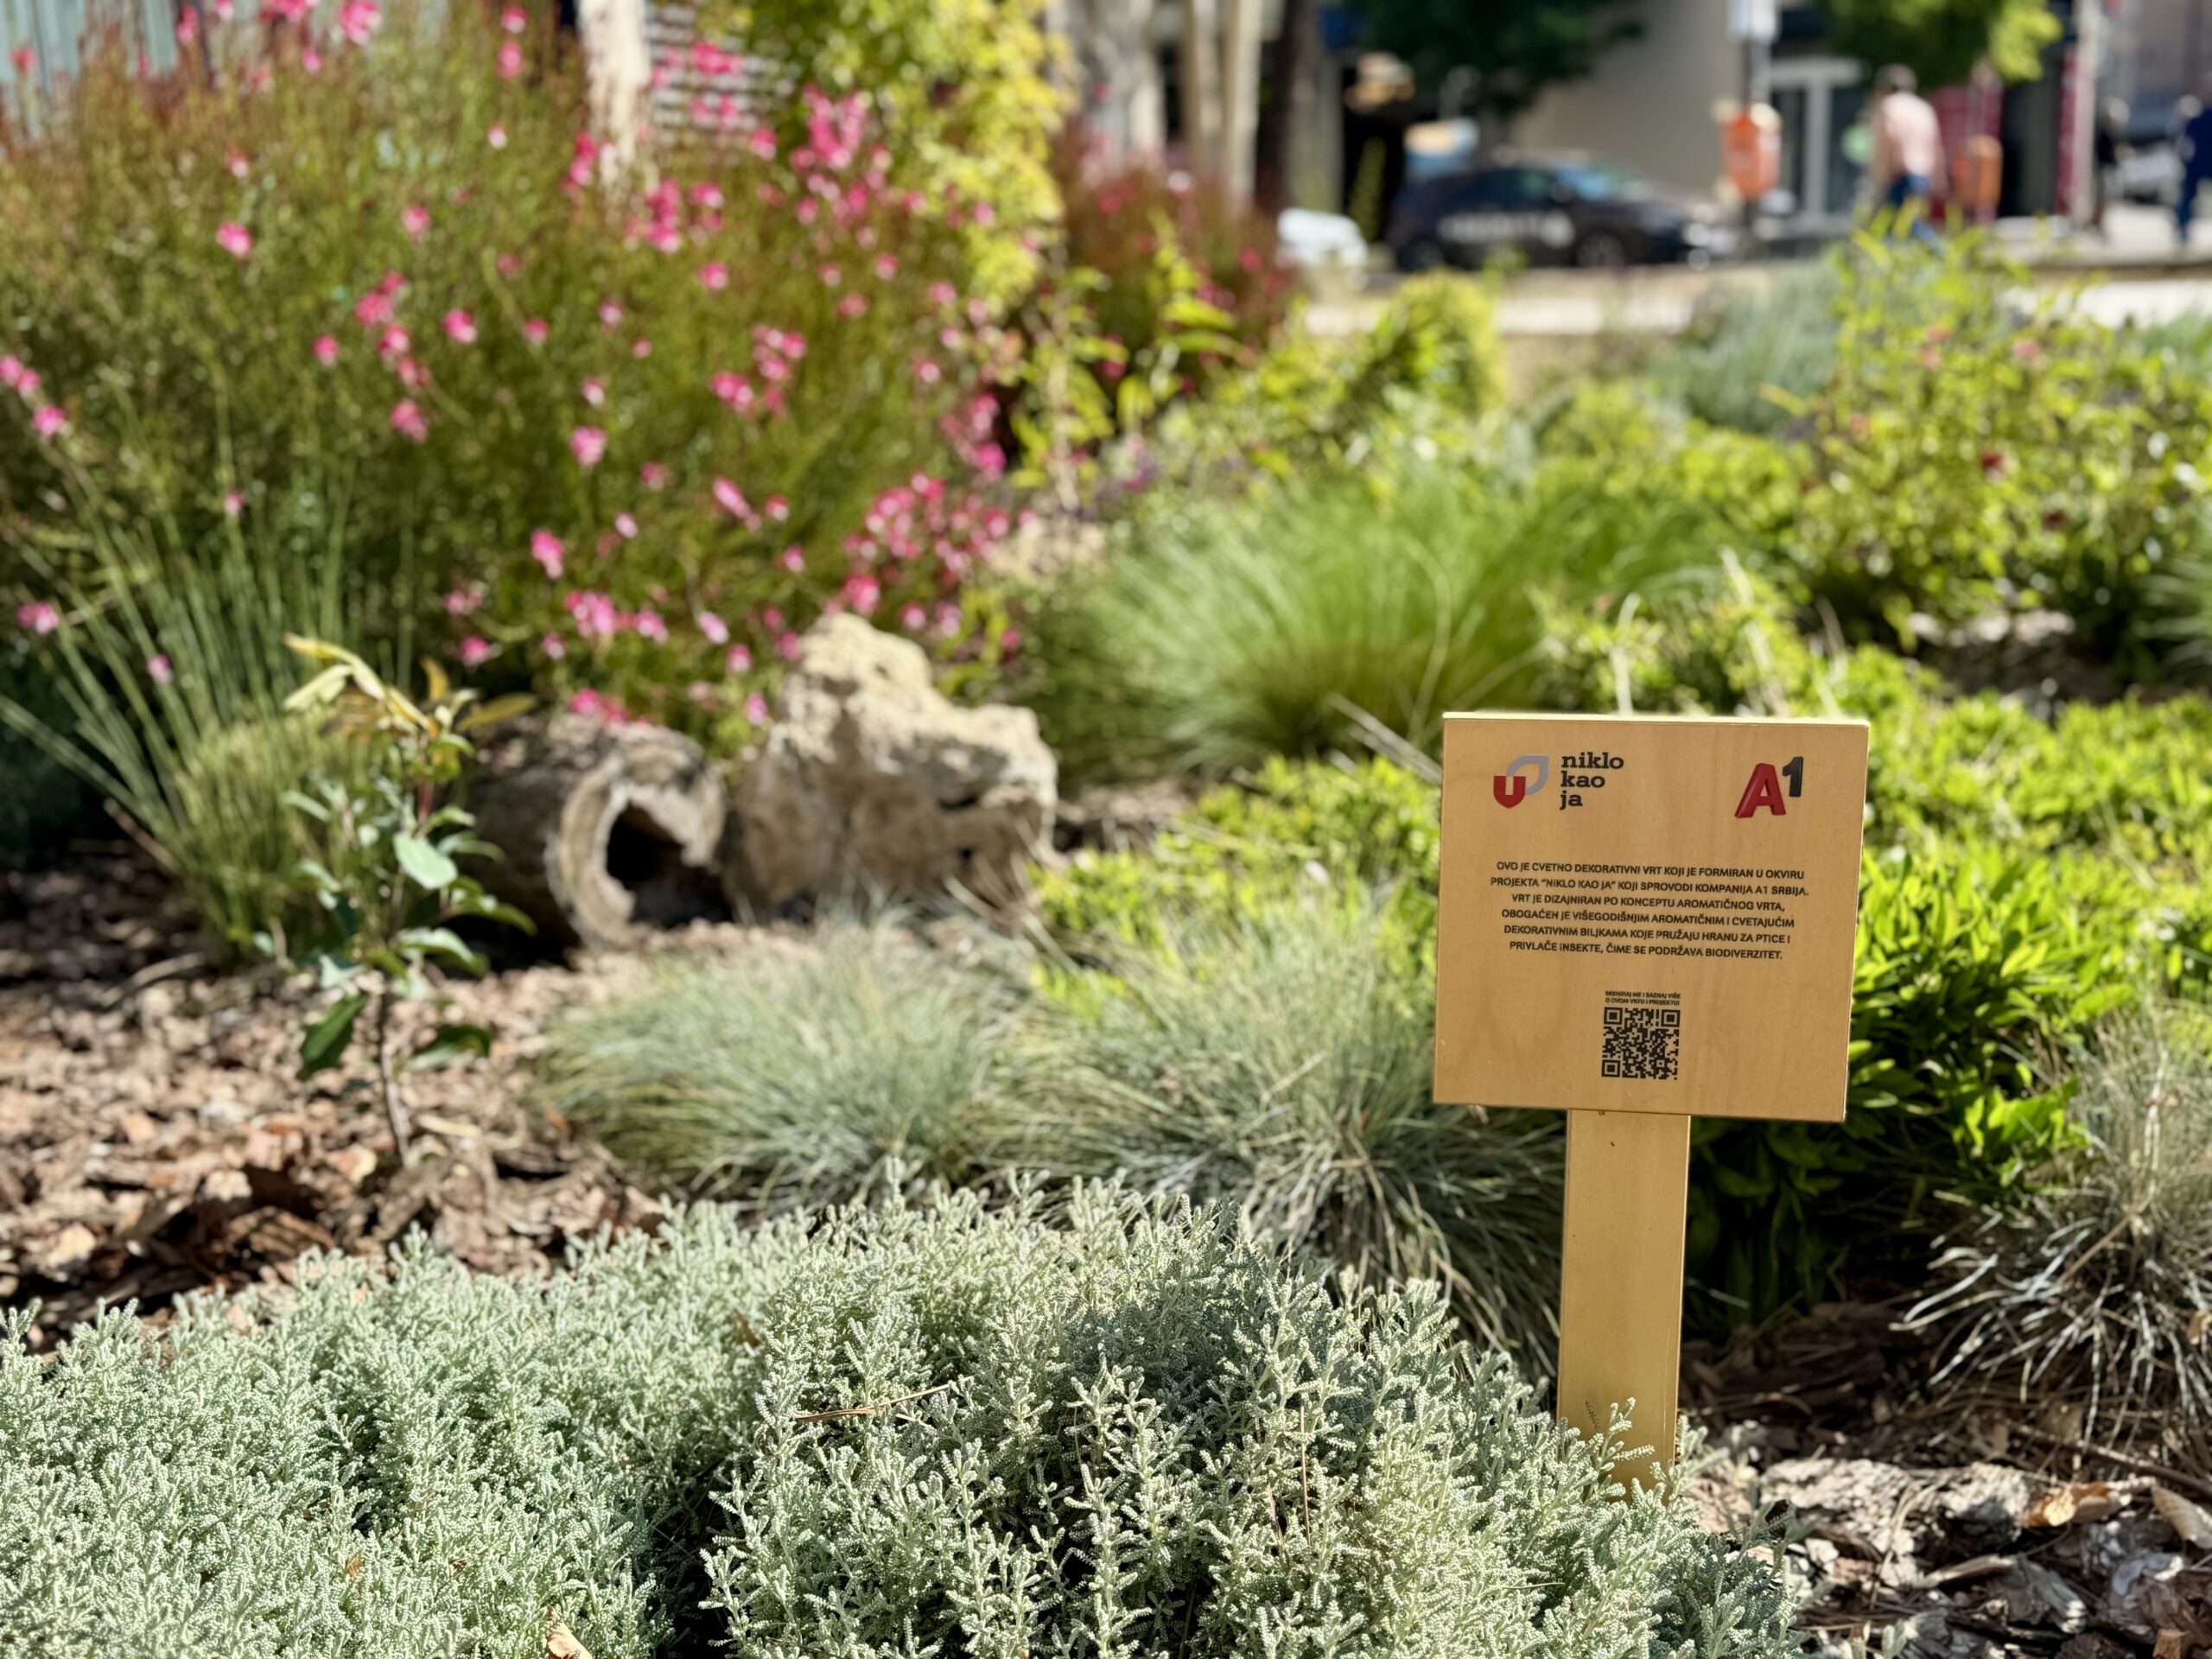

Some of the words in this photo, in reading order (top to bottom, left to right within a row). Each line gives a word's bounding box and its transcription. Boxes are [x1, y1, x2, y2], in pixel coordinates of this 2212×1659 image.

[1560, 752, 1624, 769] niklo
[1560, 771, 1605, 788] kao
[1734, 756, 1803, 818] A1
[1560, 791, 1583, 810] ja
[1497, 861, 1518, 870] OVO
[1520, 862, 1529, 872] JE
[1532, 862, 1573, 872] CVETNO
[1574, 864, 1641, 874] DEKORATIVNI
[1643, 866, 1662, 874] VRT
[1664, 867, 1684, 876] KOJI
[1687, 868, 1696, 877] JE
[1699, 868, 1753, 877] FORMIRAN
[1756, 869, 1763, 878] U
[1765, 870, 1804, 879] OKVIRU
[1491, 877, 1539, 887] PROJEKTA
[1579, 880, 1599, 889] KAO
[1618, 881, 1637, 891] KOJI
[1640, 882, 1693, 892] SPROVODI
[1695, 884, 1752, 893] KOMPANIJA
[1755, 885, 1768, 894] A1
[1771, 886, 1809, 896] SRBIJA.
[1512, 893, 1530, 902] VRT
[1533, 894, 1541, 904] JE
[1545, 895, 1601, 905] DIZAJNIRAN
[1604, 897, 1618, 906] PO
[1621, 897, 1675, 907] KONCEPTU
[1677, 899, 1753, 910] AROMATIČNOG
[1756, 901, 1785, 912] VRTA,
[1502, 908, 1558, 919] OBOGAĆEN
[1560, 911, 1571, 920] JE
[1573, 910, 1649, 924] VIŠEGODIŠNJIM
[1651, 914, 1724, 925] AROMATIČNIM
[1732, 915, 1795, 928] CVETAJUĆIM
[1504, 925, 1578, 935] DEKORATIVNIM
[1580, 928, 1628, 938] BILJKAMA
[1630, 930, 1653, 940] KOJE
[1656, 930, 1700, 941] PRUŽAJU
[1702, 932, 1738, 942] HRANU
[1739, 933, 1753, 942] ZA
[1756, 934, 1785, 943] PTICE
[1510, 940, 1557, 950] PRIVLAČE
[1560, 943, 1604, 954] INSEKTE,
[1606, 943, 1631, 954] ČIME
[1634, 945, 1645, 955] SE
[1649, 945, 1702, 957] PODRŽAVA
[1705, 949, 1783, 959] BIODIVERZITET.
